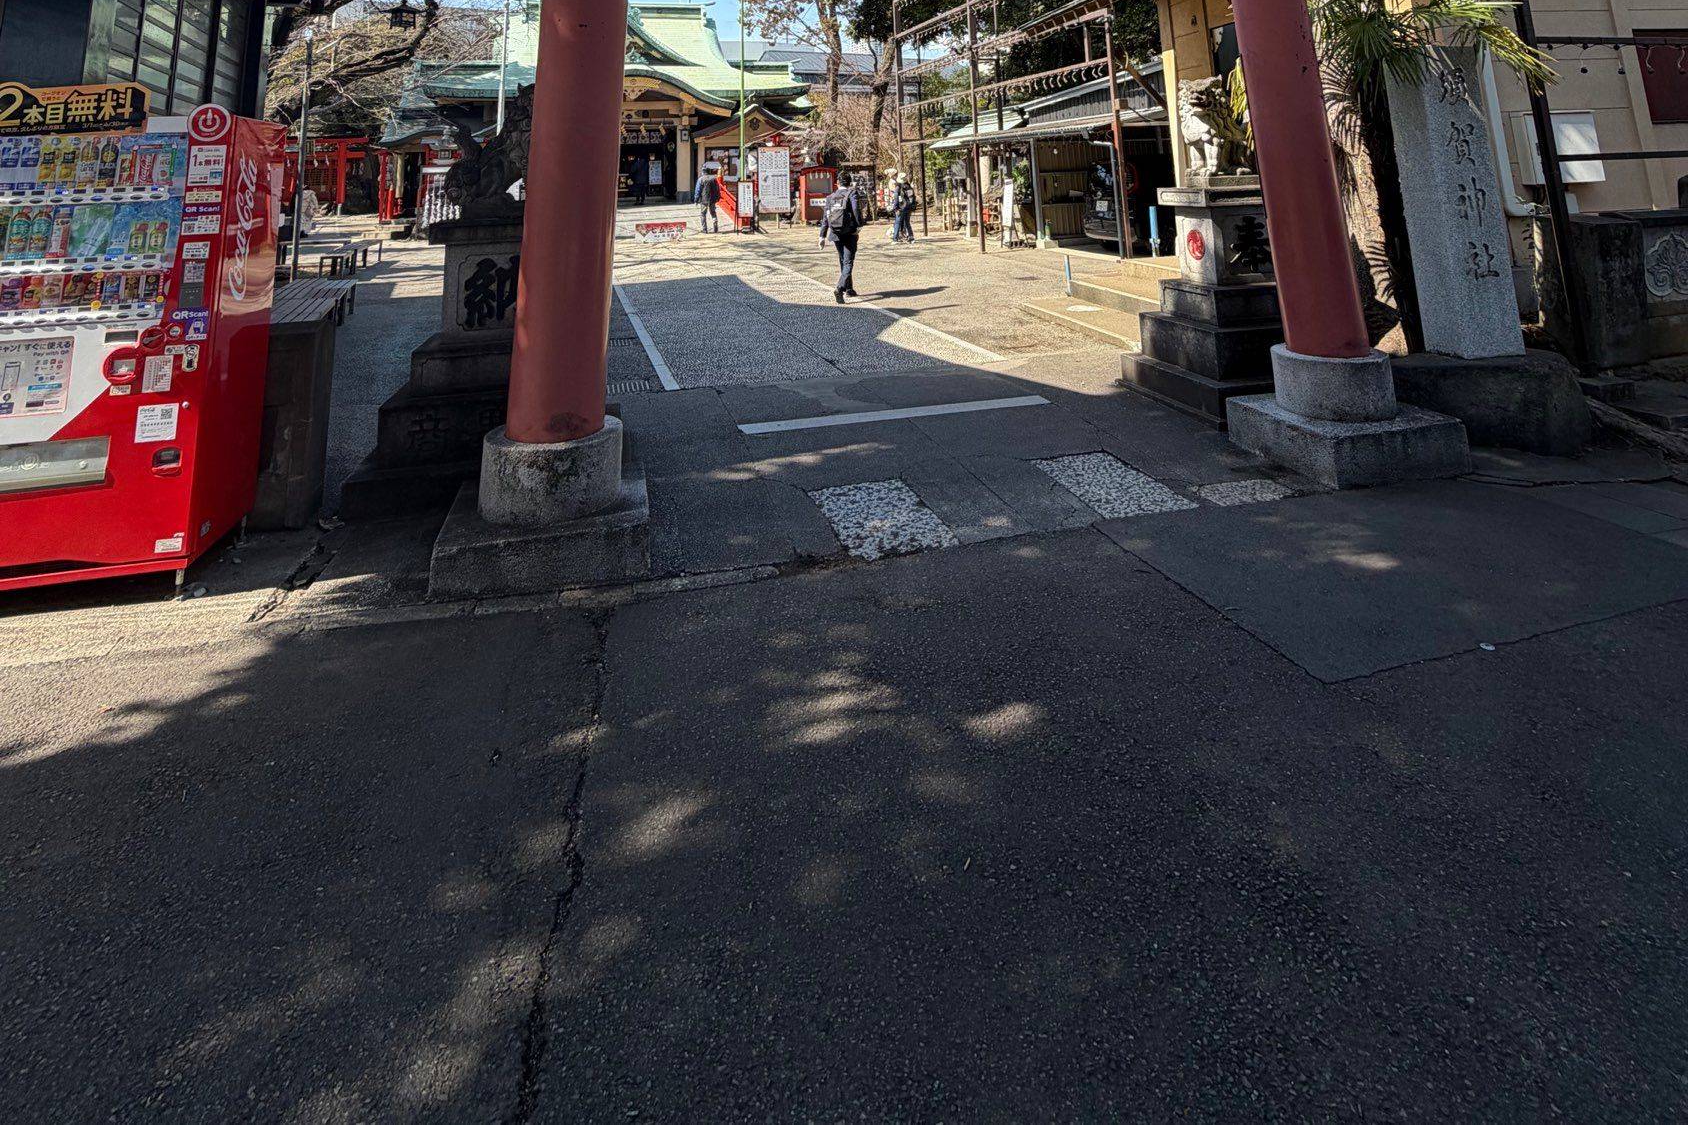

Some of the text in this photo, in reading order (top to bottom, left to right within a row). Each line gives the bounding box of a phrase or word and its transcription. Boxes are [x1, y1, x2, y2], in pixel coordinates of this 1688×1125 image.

[0, 86, 134, 127] 2本目無料
[172, 310, 189, 320] QR
